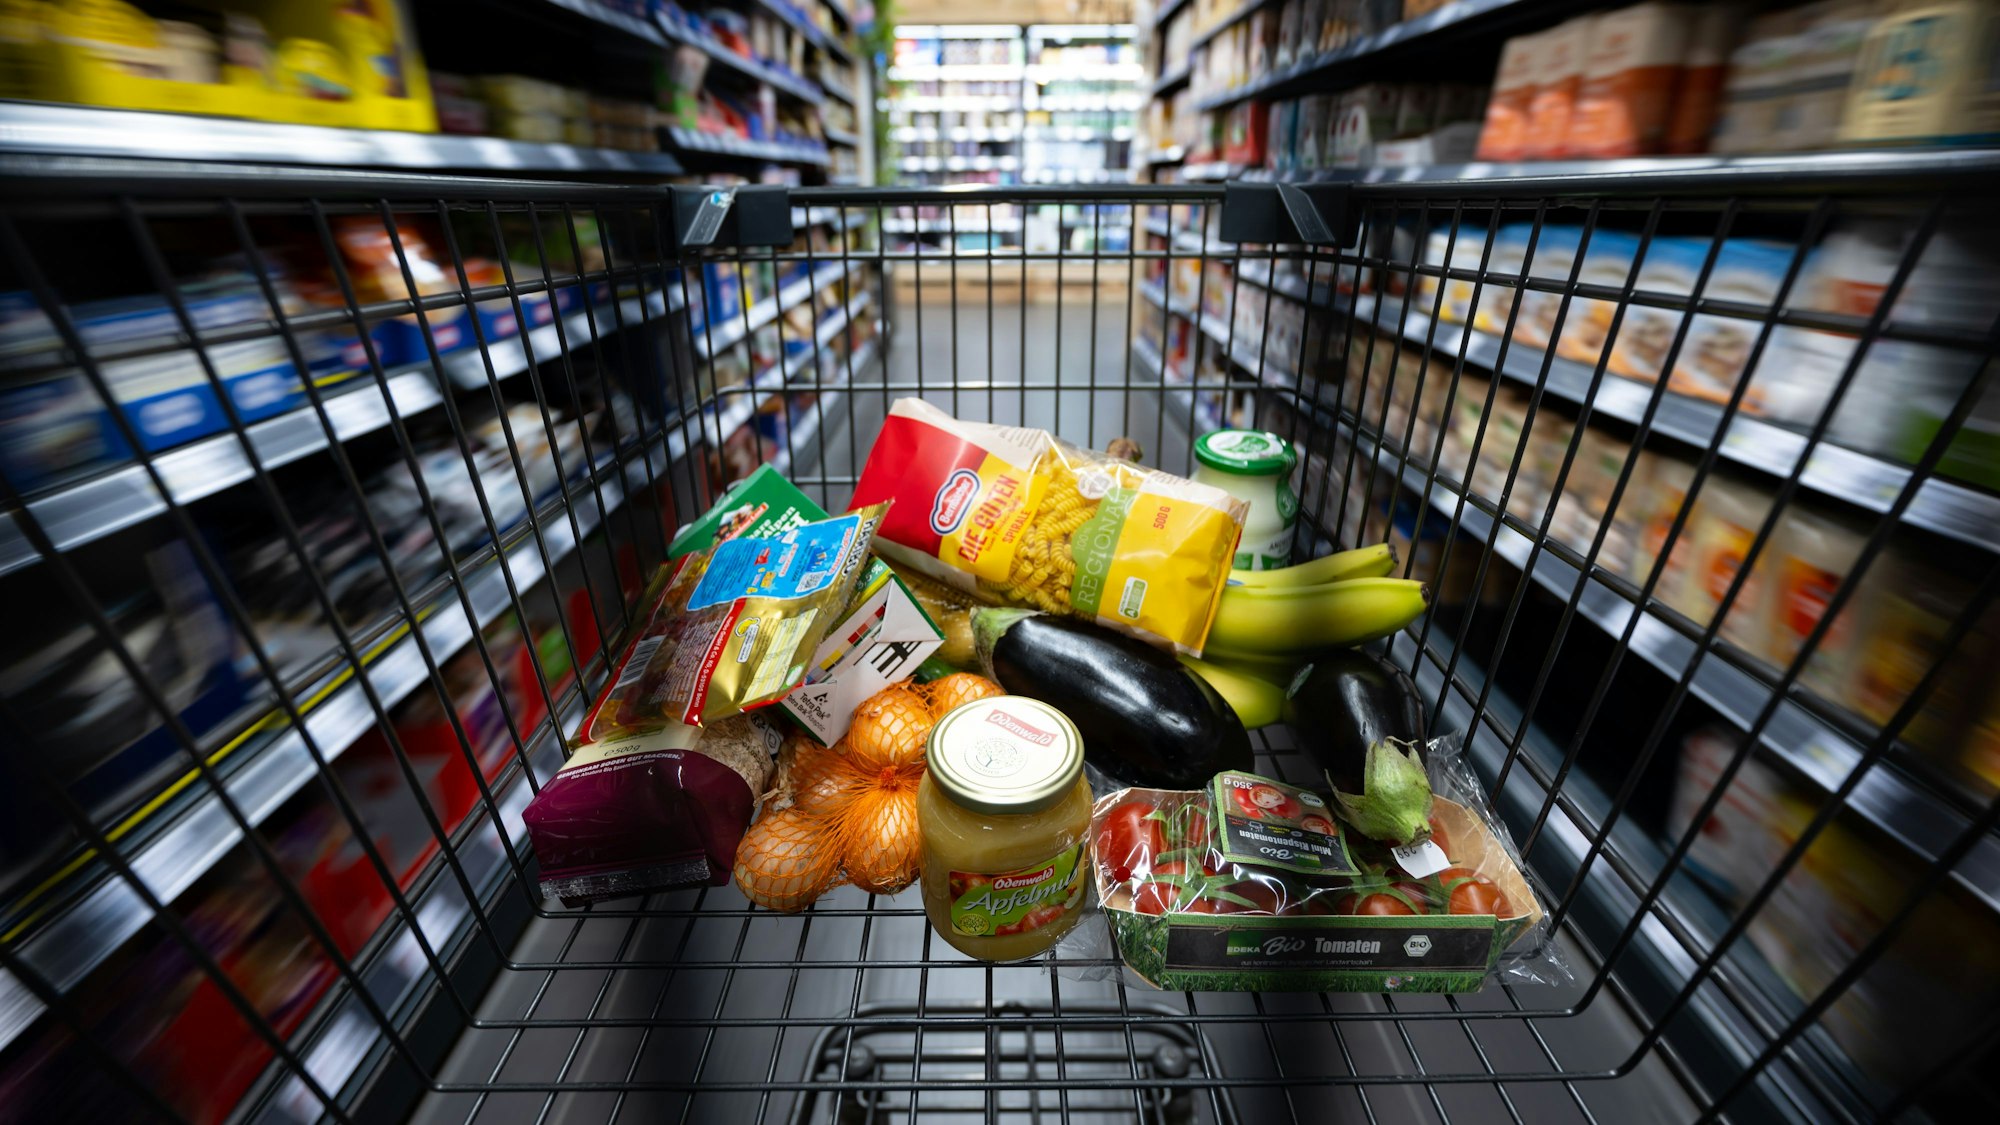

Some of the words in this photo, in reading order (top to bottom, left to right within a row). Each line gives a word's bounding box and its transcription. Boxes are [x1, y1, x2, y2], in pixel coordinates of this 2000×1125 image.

[762, 506, 796, 541] Alpen
[958, 529, 988, 564] DIE
[974, 474, 1020, 530] GUTEN
[1002, 510, 1033, 544] SPIRALE
[1153, 511, 1169, 530] 500
[1076, 533, 1088, 551] 100
[1077, 494, 1131, 605] REGIONAL
[787, 694, 799, 708] Tetra
[800, 692, 815, 710] Tetra
[989, 711, 1052, 746] Odenwald
[557, 762, 600, 780] GEMEINSAM
[600, 757, 626, 769] BODEN
[627, 754, 644, 763] GUT
[1233, 780, 1252, 790] 350
[1239, 829, 1310, 851] Rispentomaten
[1311, 843, 1332, 856] Mini
[1260, 846, 1294, 860] Bio
[994, 868, 1054, 889] Odenwald
[1227, 946, 1261, 954] EDEKA
[1263, 936, 1306, 956] Bio
[1315, 937, 1381, 954] Tomaten
